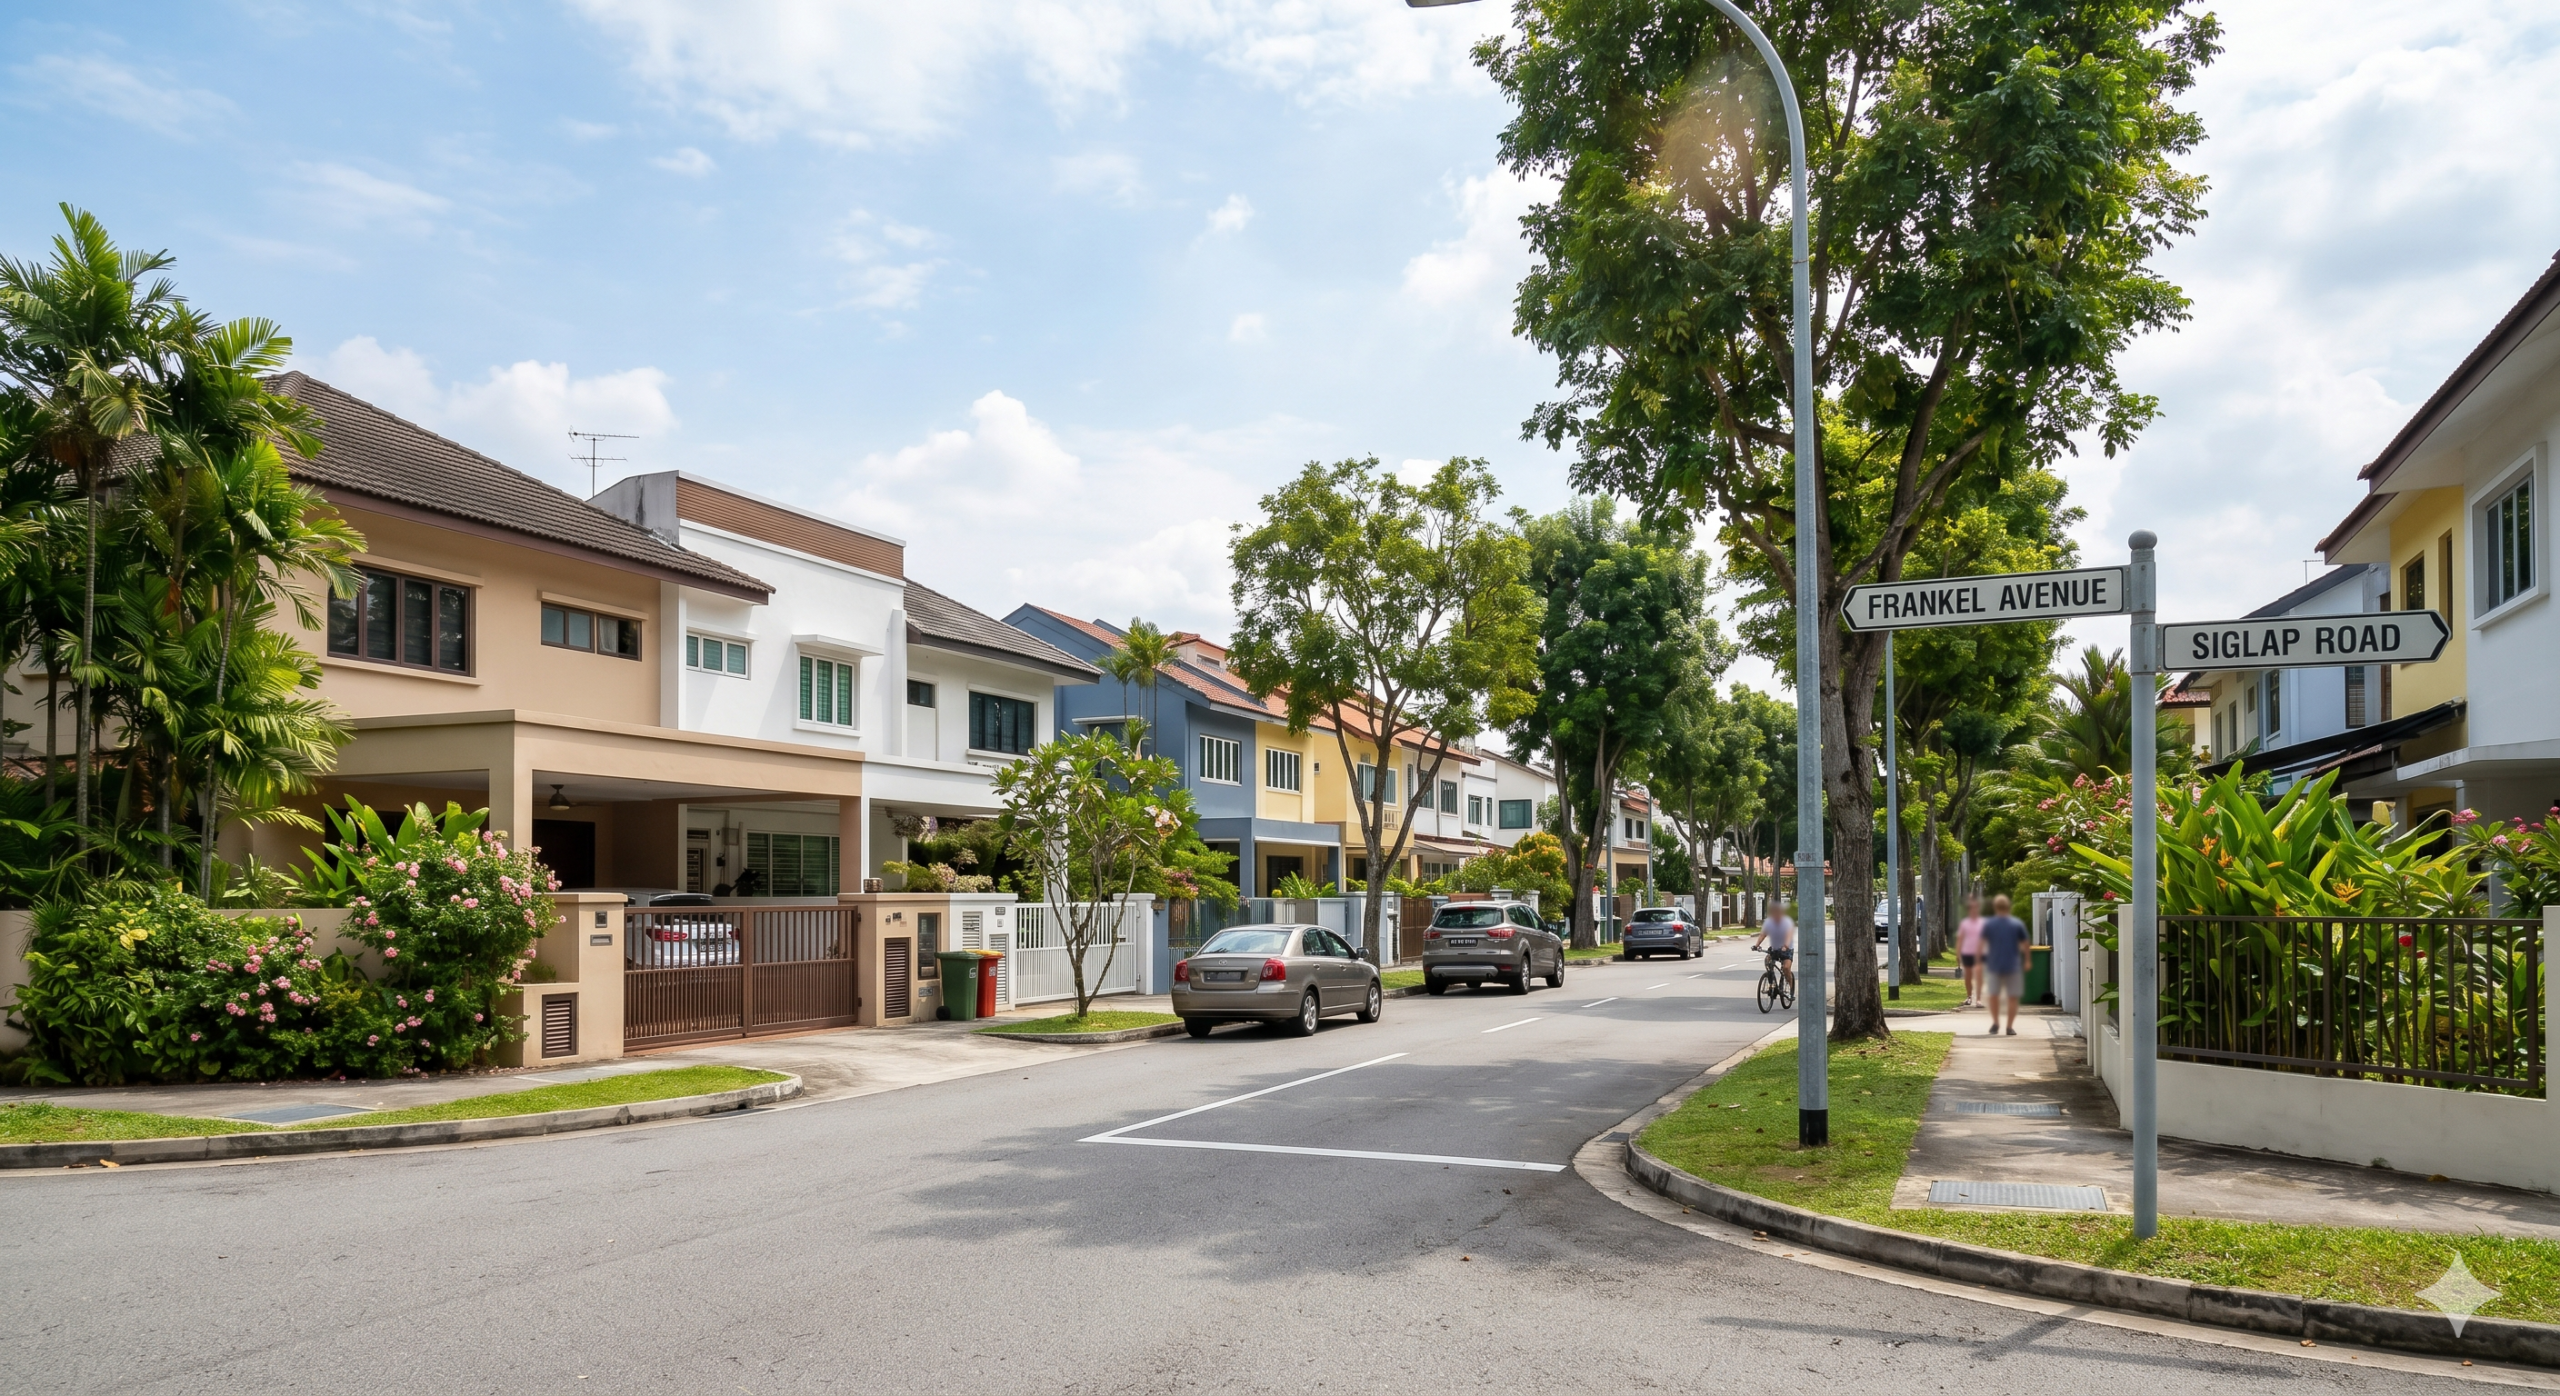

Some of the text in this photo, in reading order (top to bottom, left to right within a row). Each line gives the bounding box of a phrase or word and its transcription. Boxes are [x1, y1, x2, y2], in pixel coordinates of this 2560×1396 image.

[1868, 577, 2107, 620] FRANKEL AVENUE
[2191, 623, 2402, 661] SIGLAP ROAD
